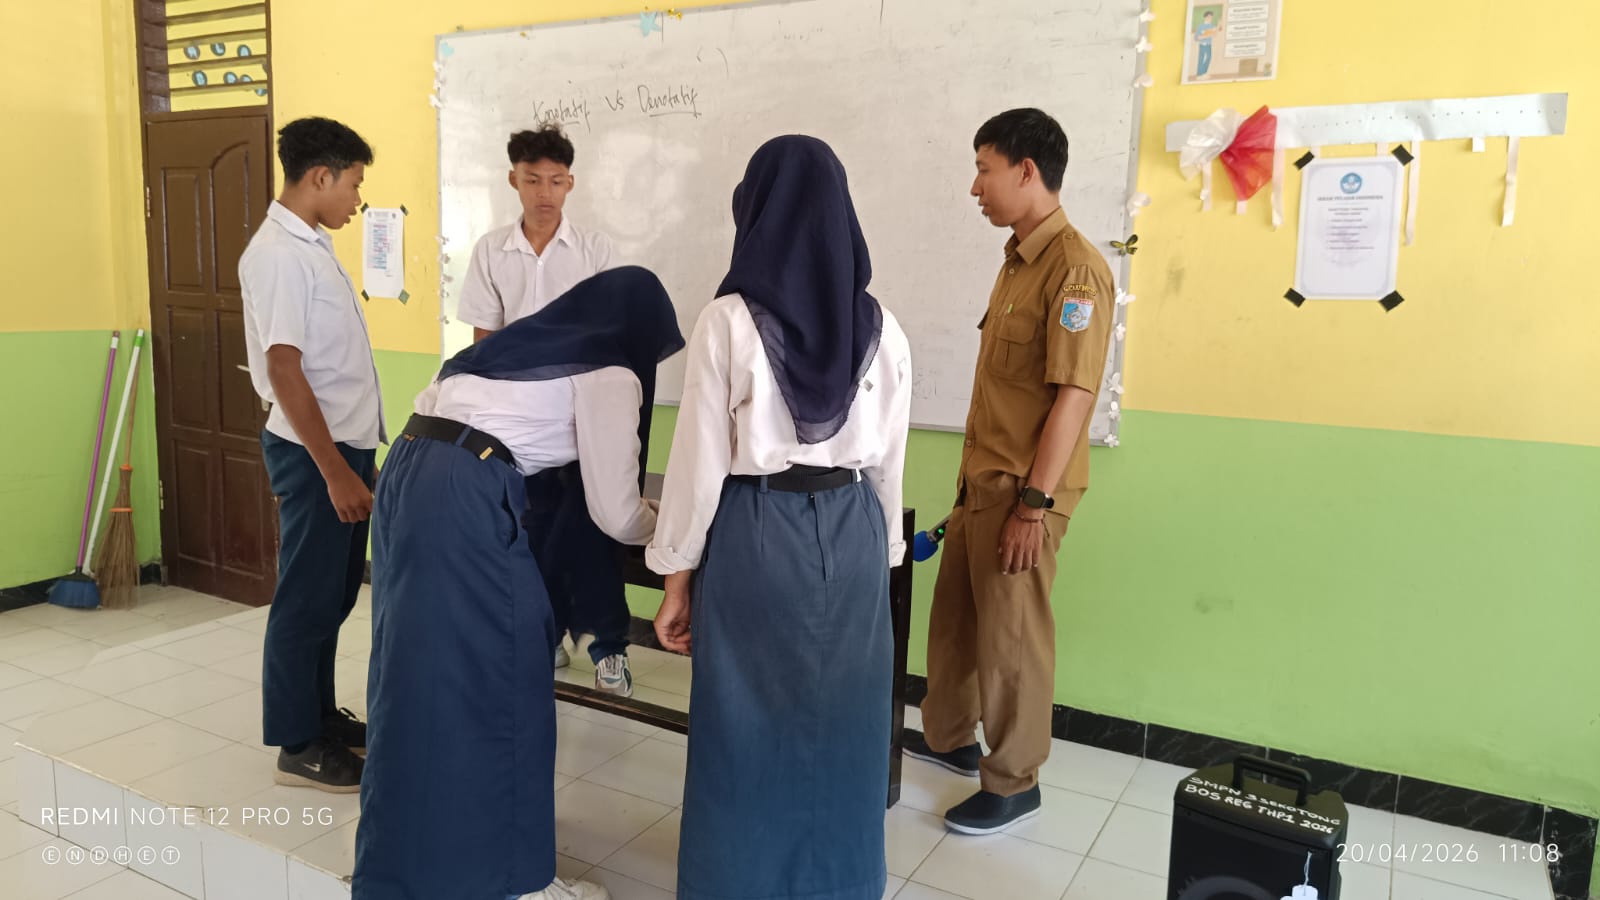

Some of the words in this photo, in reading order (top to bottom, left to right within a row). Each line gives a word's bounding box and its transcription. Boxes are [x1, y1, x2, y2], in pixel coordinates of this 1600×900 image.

[1189, 776, 1242, 796] SMPN
[1184, 783, 1222, 801] BOS
[1223, 795, 1254, 810] REG
[1257, 805, 1296, 824] THP1
[1299, 819, 1335, 835] 2026
